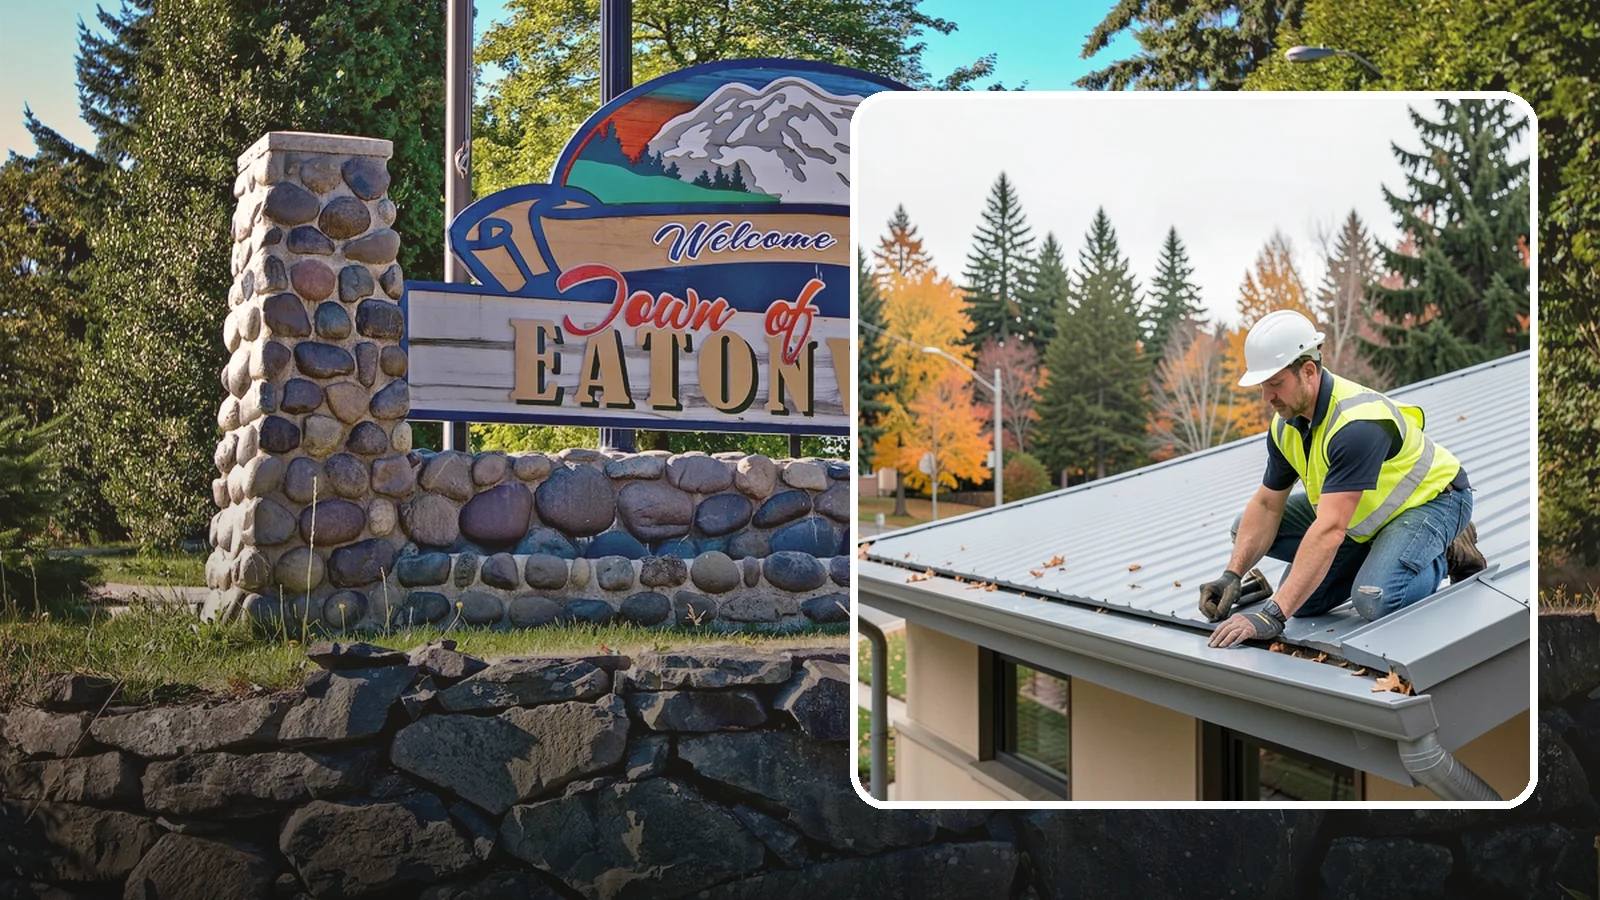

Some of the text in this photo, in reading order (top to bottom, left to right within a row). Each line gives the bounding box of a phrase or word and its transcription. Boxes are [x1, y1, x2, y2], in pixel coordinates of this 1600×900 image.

[654, 220, 837, 264] Welcome
[556, 263, 826, 367] Town of
